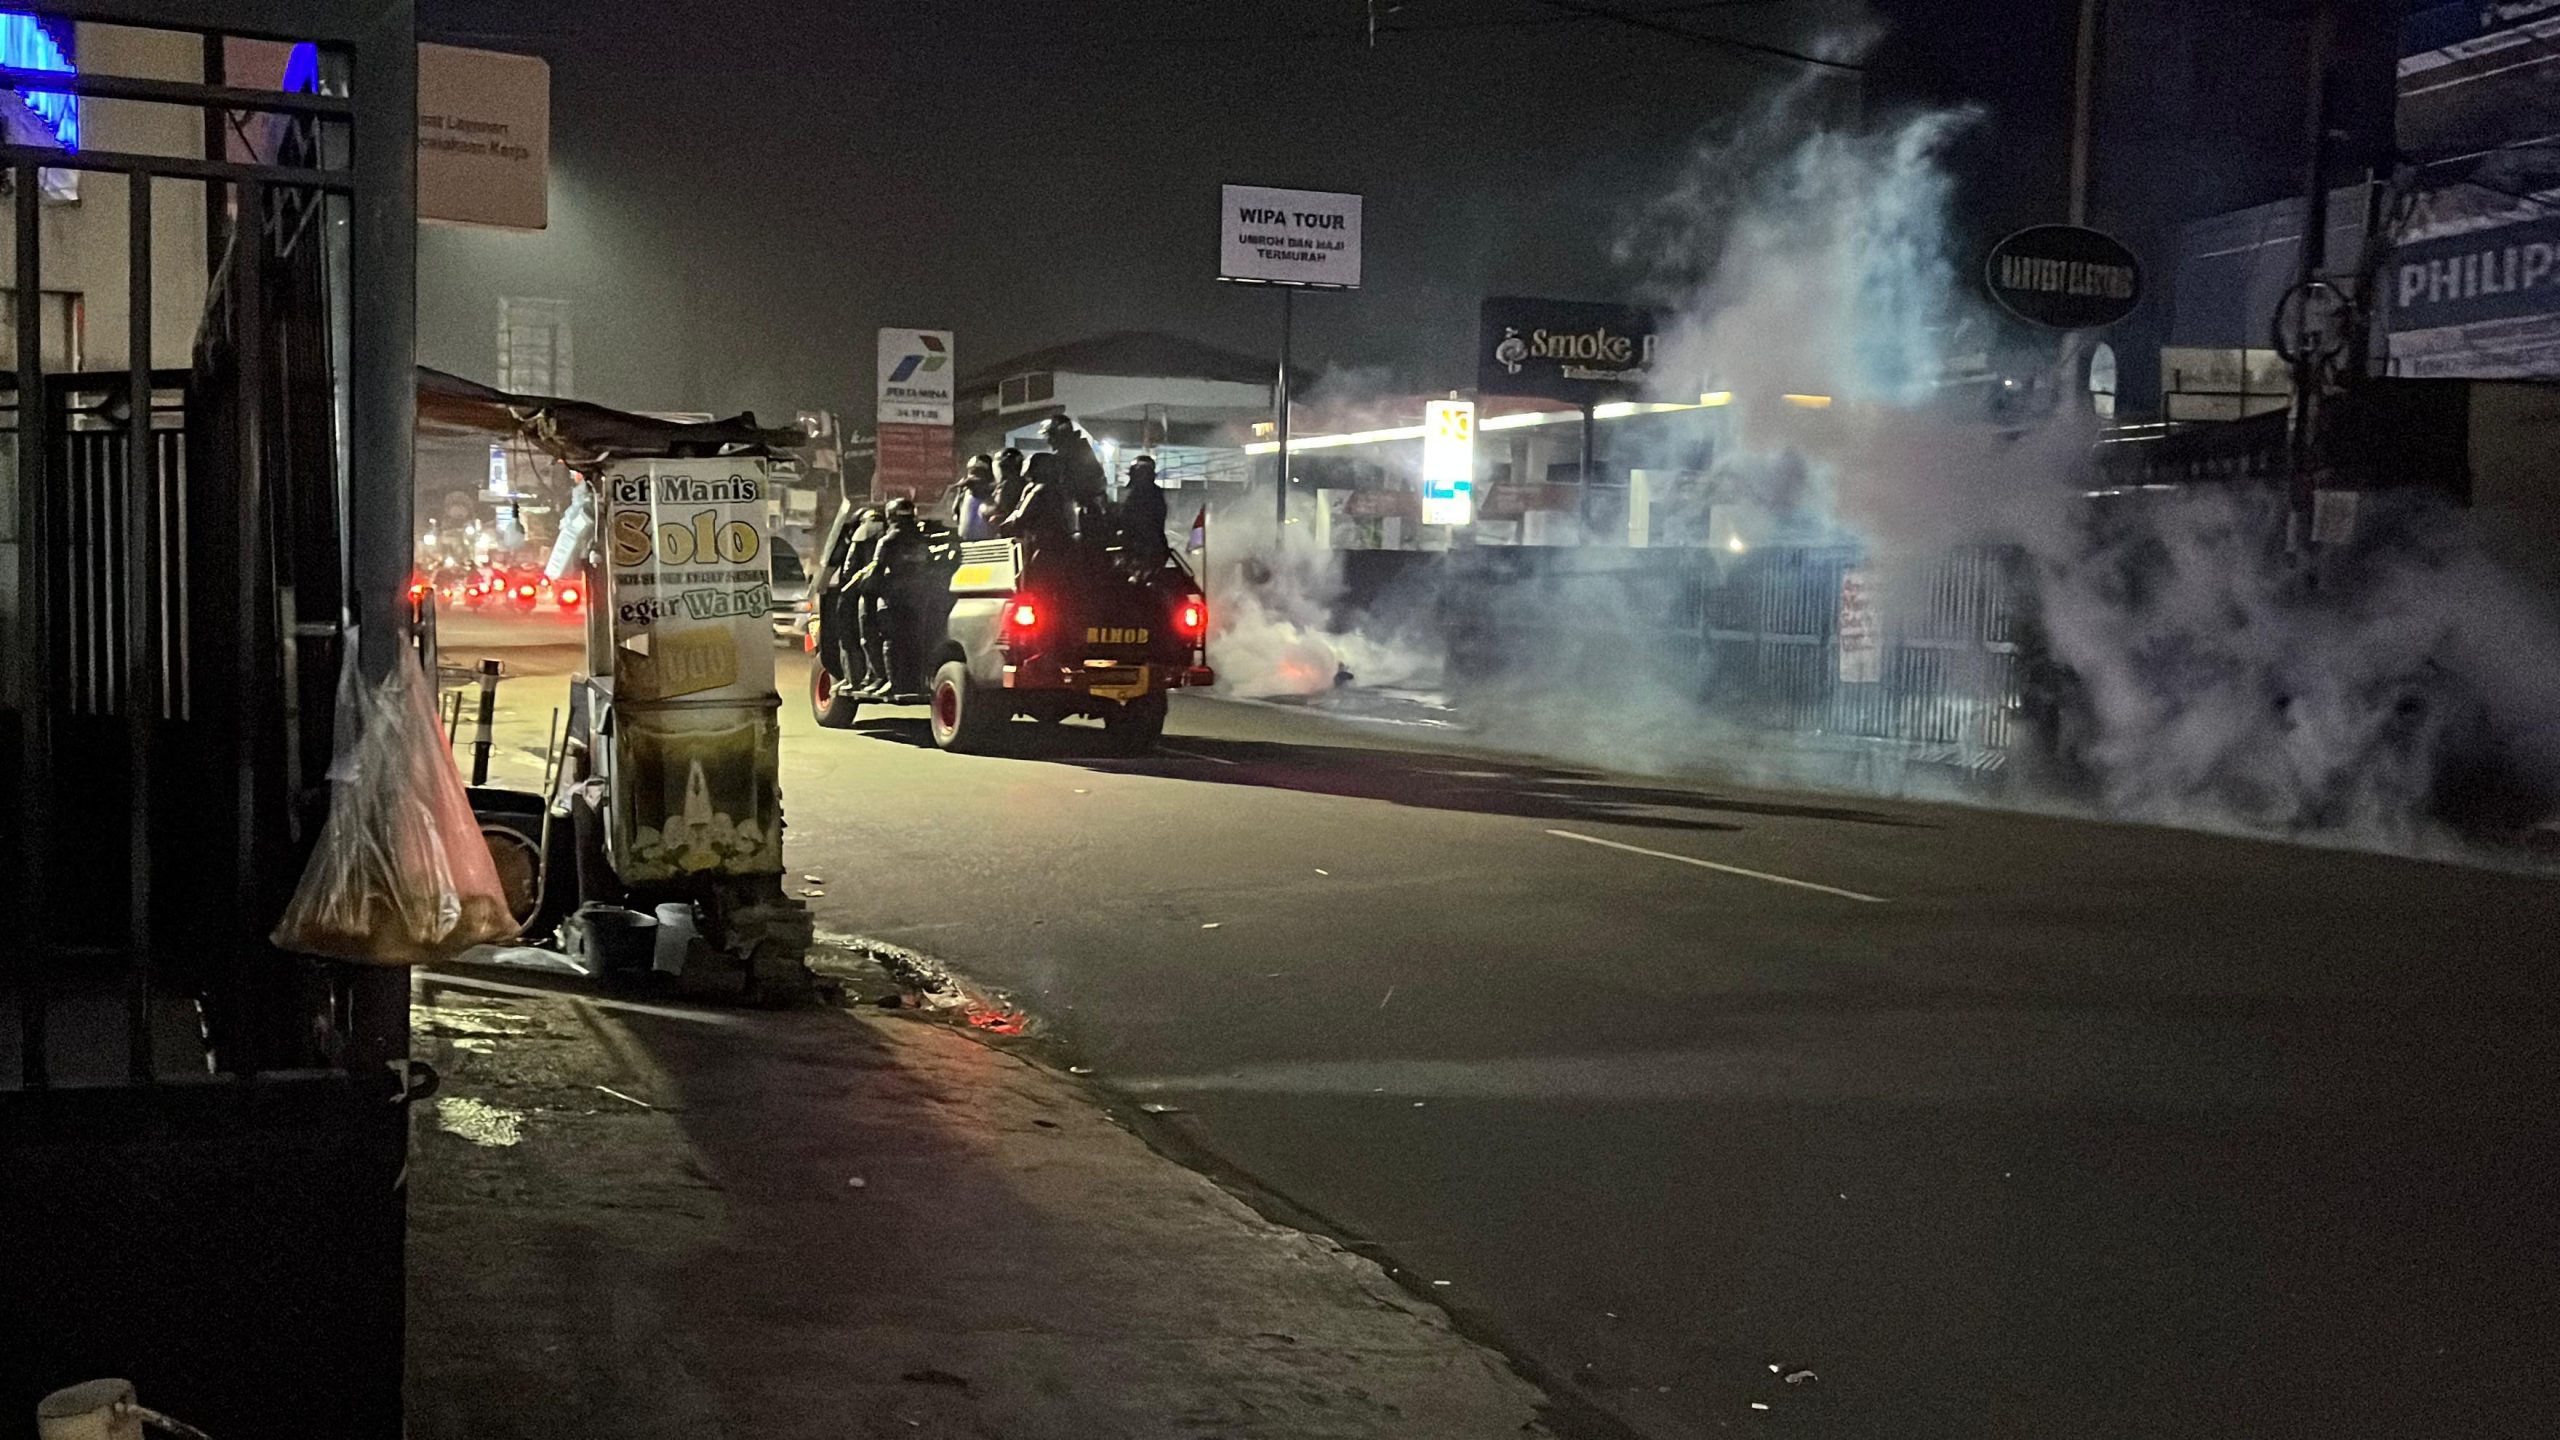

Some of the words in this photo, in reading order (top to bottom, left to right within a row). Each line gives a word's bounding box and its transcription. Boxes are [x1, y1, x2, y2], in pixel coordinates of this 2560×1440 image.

[1240, 207, 1287, 226] WIPA
[1293, 212, 1345, 230] TOUR
[1239, 234, 1284, 247] UMROH
[1287, 237, 1313, 249] DAN
[1316, 240, 1345, 251] HAJI
[1257, 248, 1327, 262] TERMURAH
[1530, 327, 1633, 363] Smoke
[885, 386, 949, 400] PERTAMINA
[663, 476, 758, 504] Manis
[614, 509, 760, 567] Solo
[684, 582, 772, 620] Wangi
